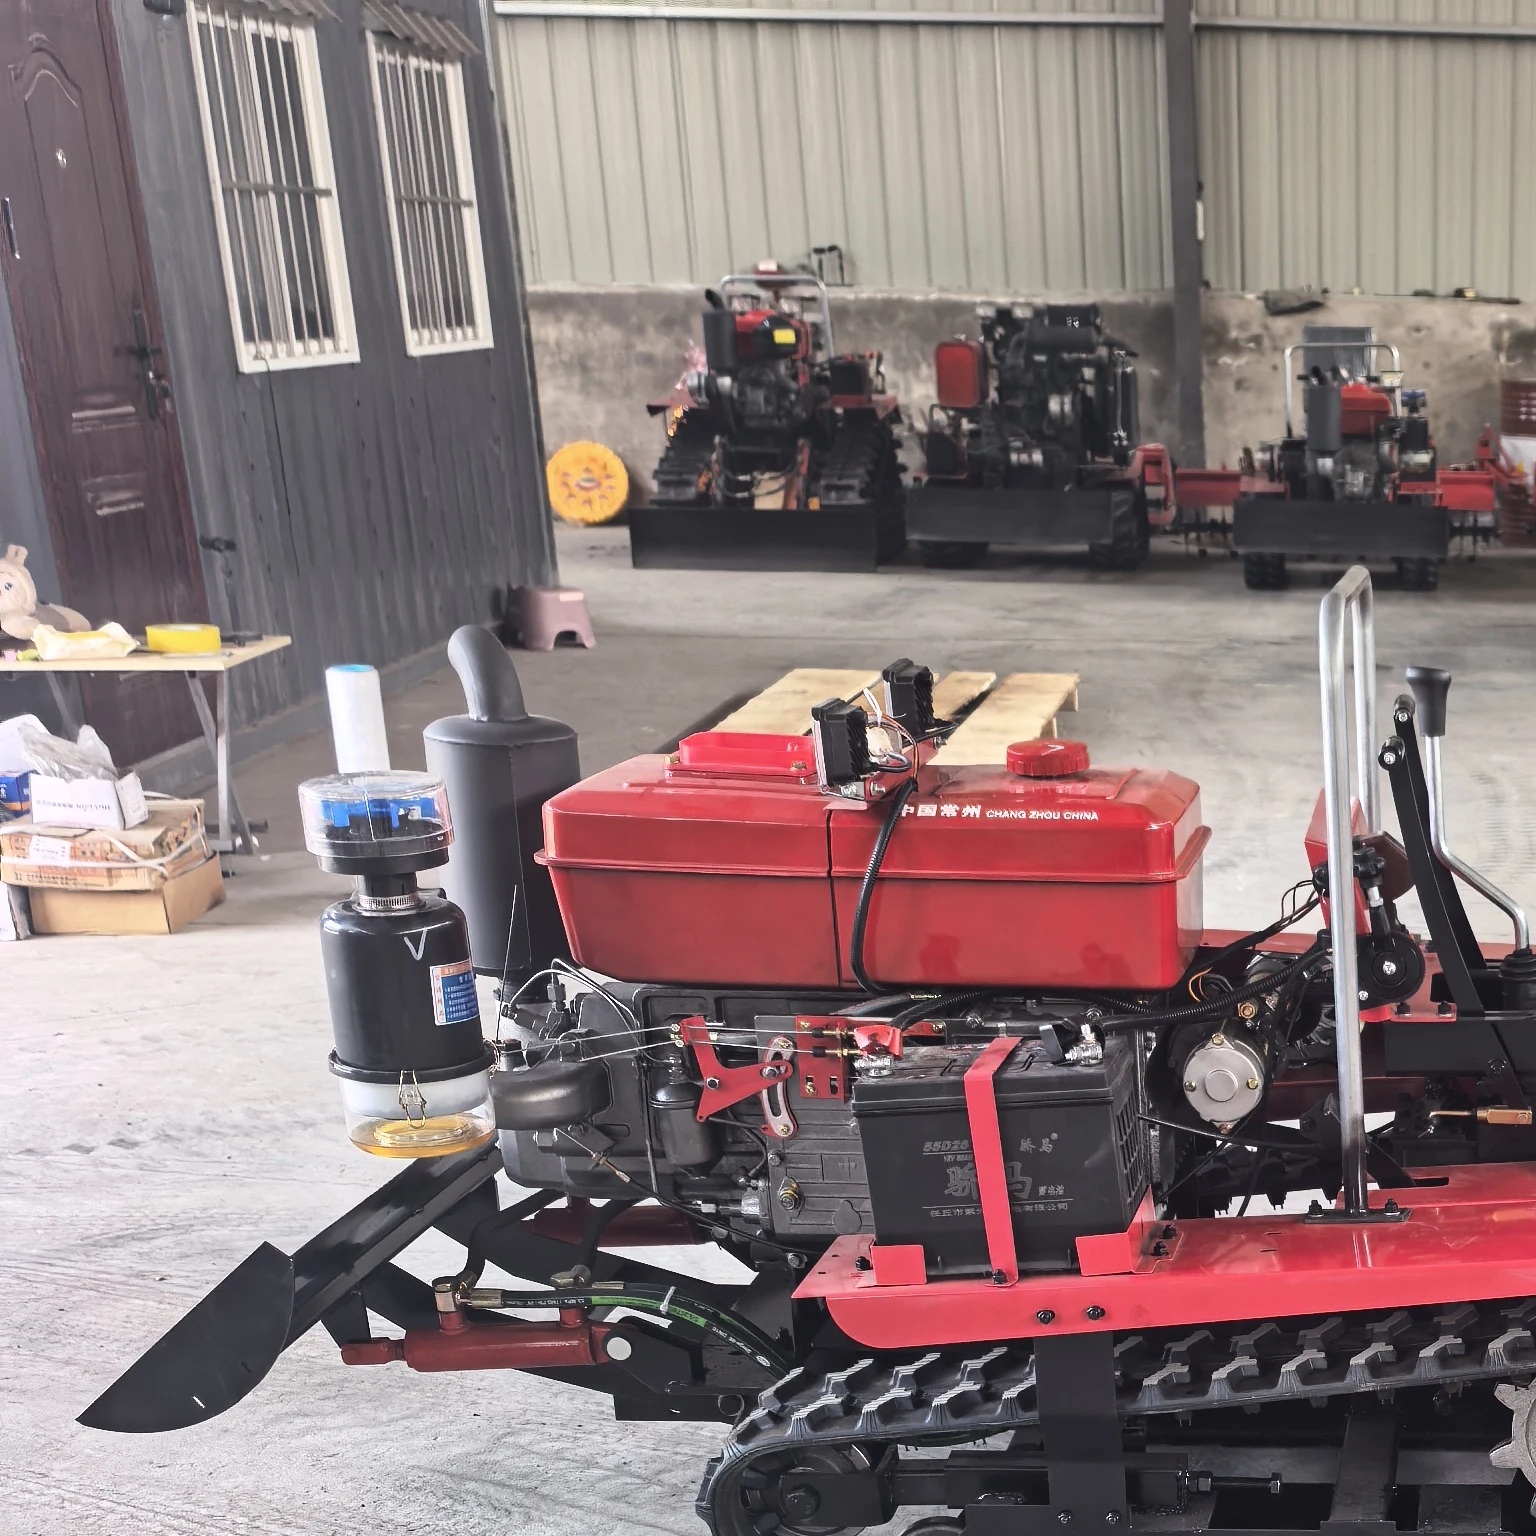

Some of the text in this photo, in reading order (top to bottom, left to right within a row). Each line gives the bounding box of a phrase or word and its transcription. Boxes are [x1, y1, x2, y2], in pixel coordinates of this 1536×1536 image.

[985, 810, 1099, 820] CHANG ZHOU CHINA
